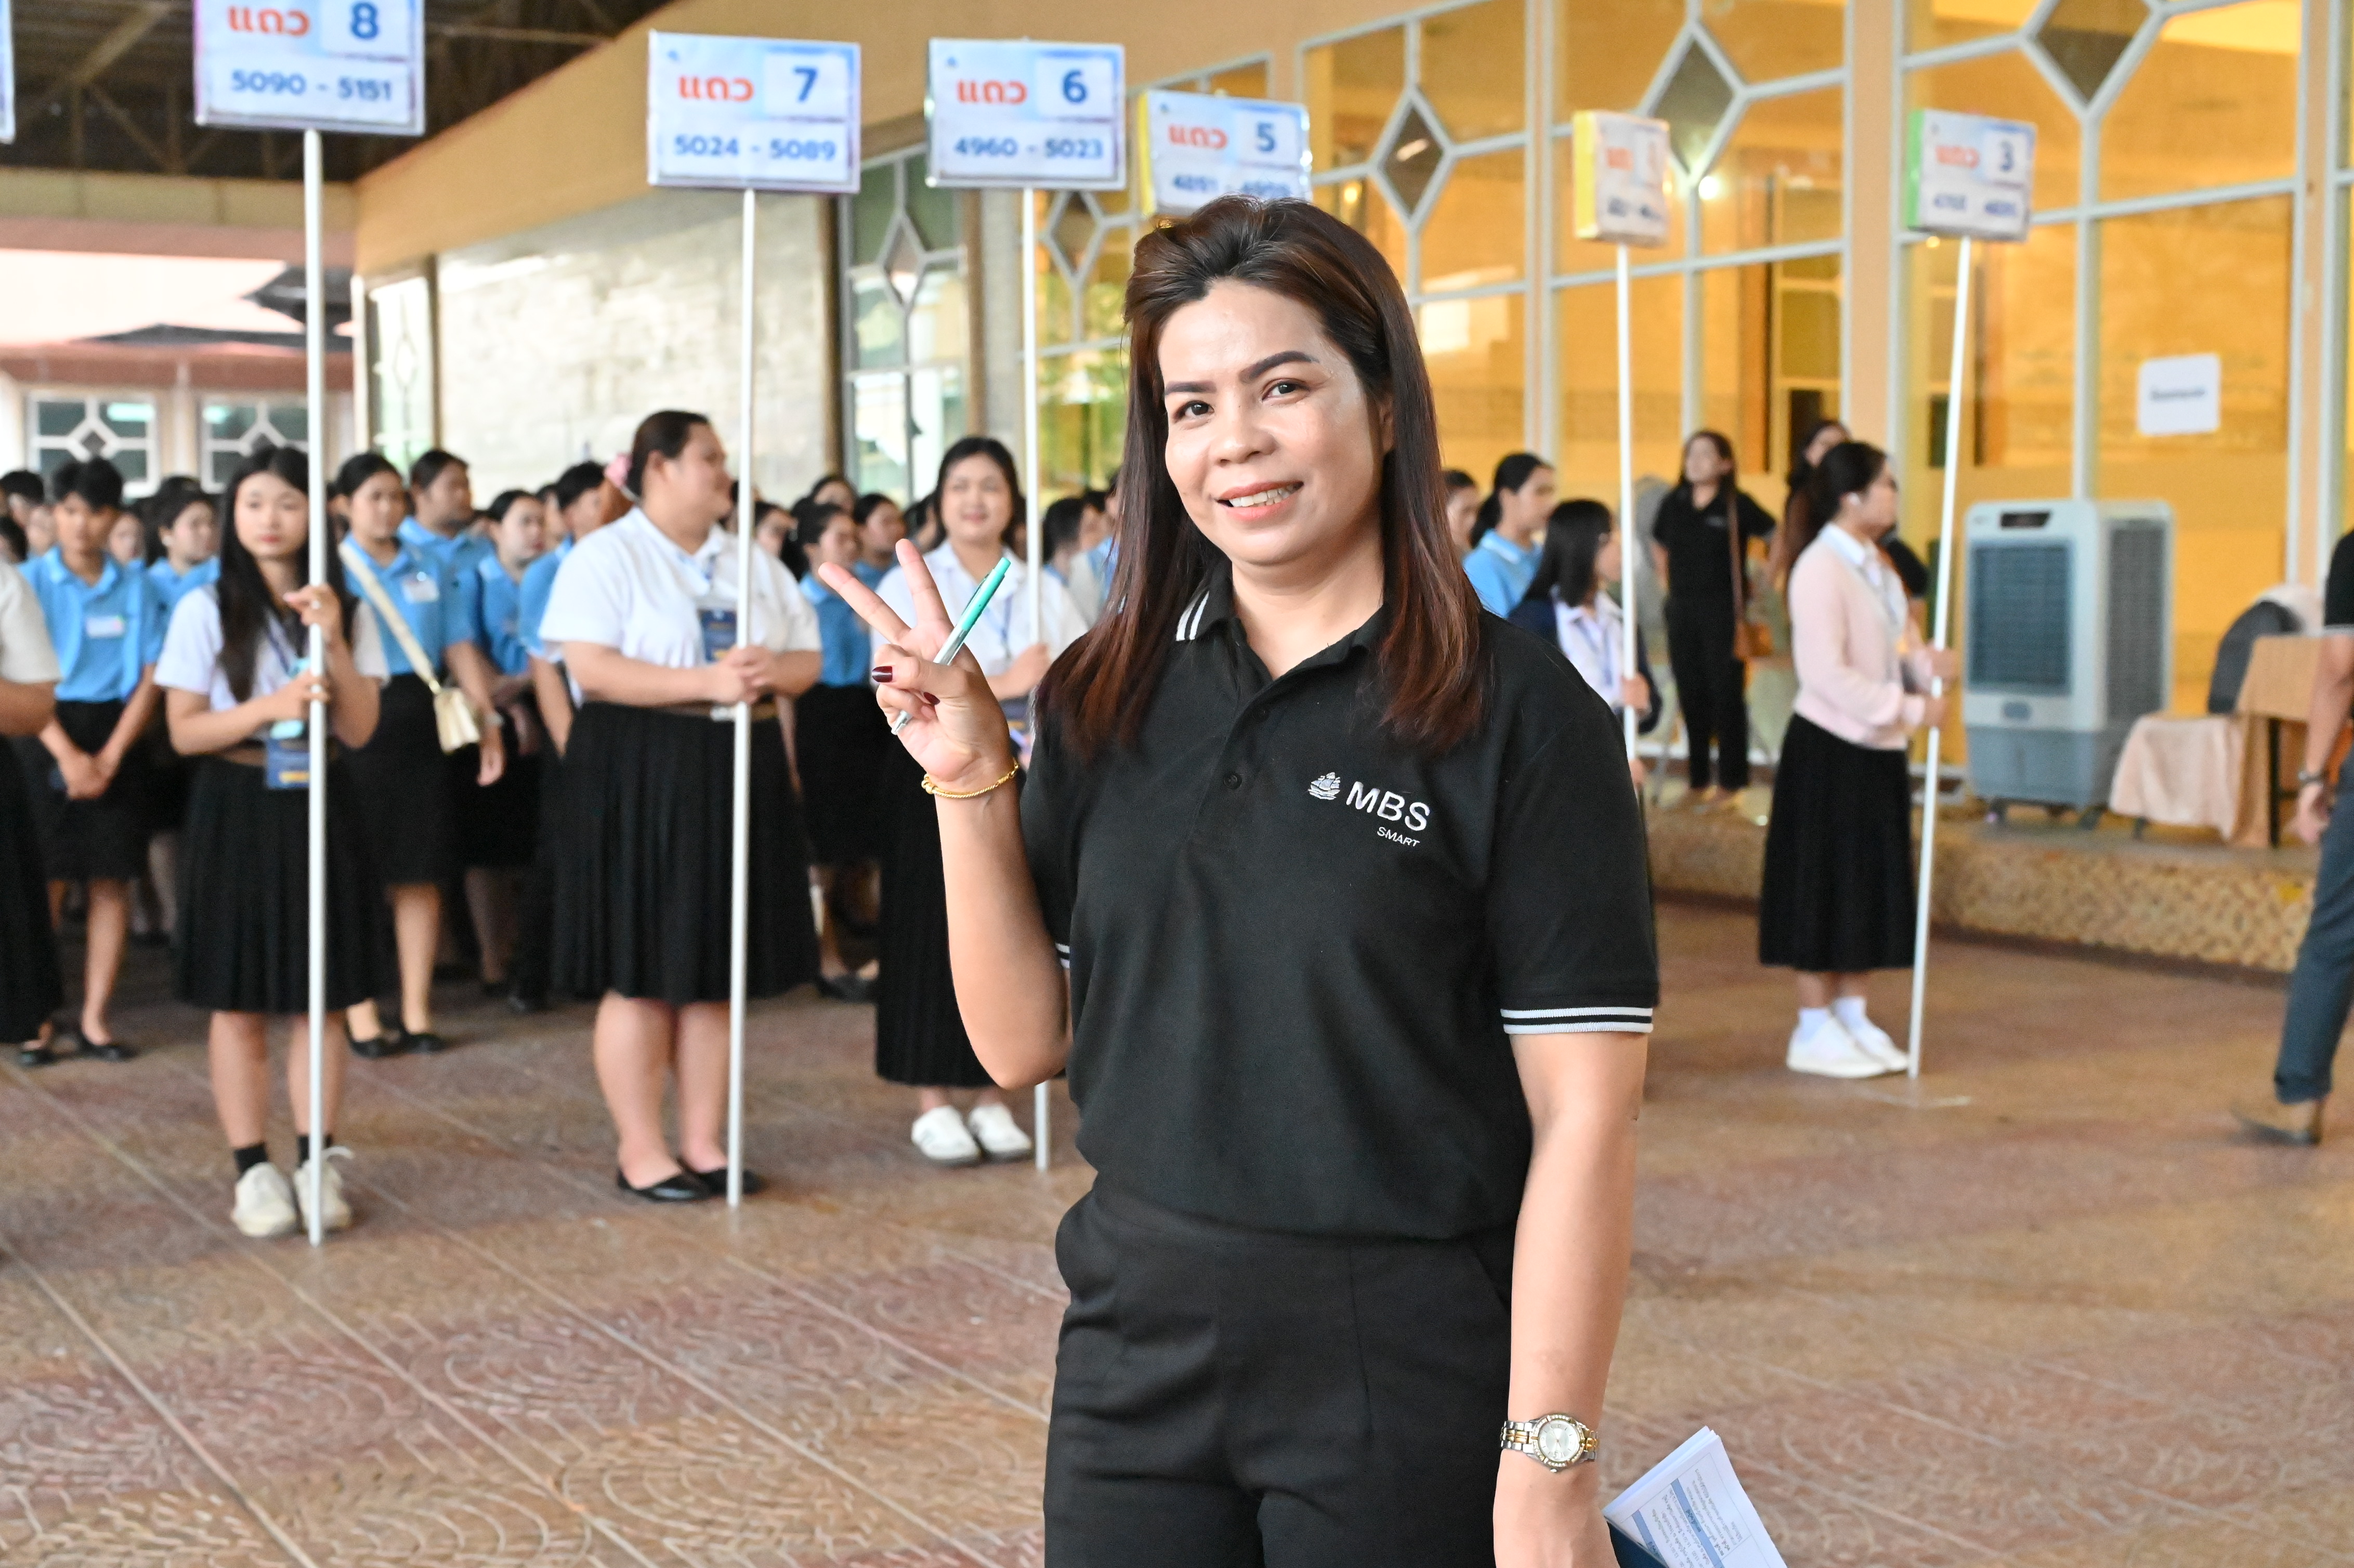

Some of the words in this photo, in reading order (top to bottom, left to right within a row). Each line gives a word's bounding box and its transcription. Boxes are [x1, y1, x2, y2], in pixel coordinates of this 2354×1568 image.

[228, 6, 311, 36] แถว
[350, 1, 379, 40] 8
[232, 70, 307, 95] 5090
[338, 77, 391, 101] 5151
[679, 77, 753, 101] แถว
[794, 67, 818, 101] 7
[958, 81, 1027, 104] แถว
[1062, 70, 1088, 103] 6
[674, 135, 739, 156] 5024
[955, 138, 1017, 156] 4960
[1169, 126, 1227, 149] แถว
[1257, 122, 1276, 153] 5
[1346, 781, 1430, 831] MBS
[1377, 827, 1420, 846] SMART
